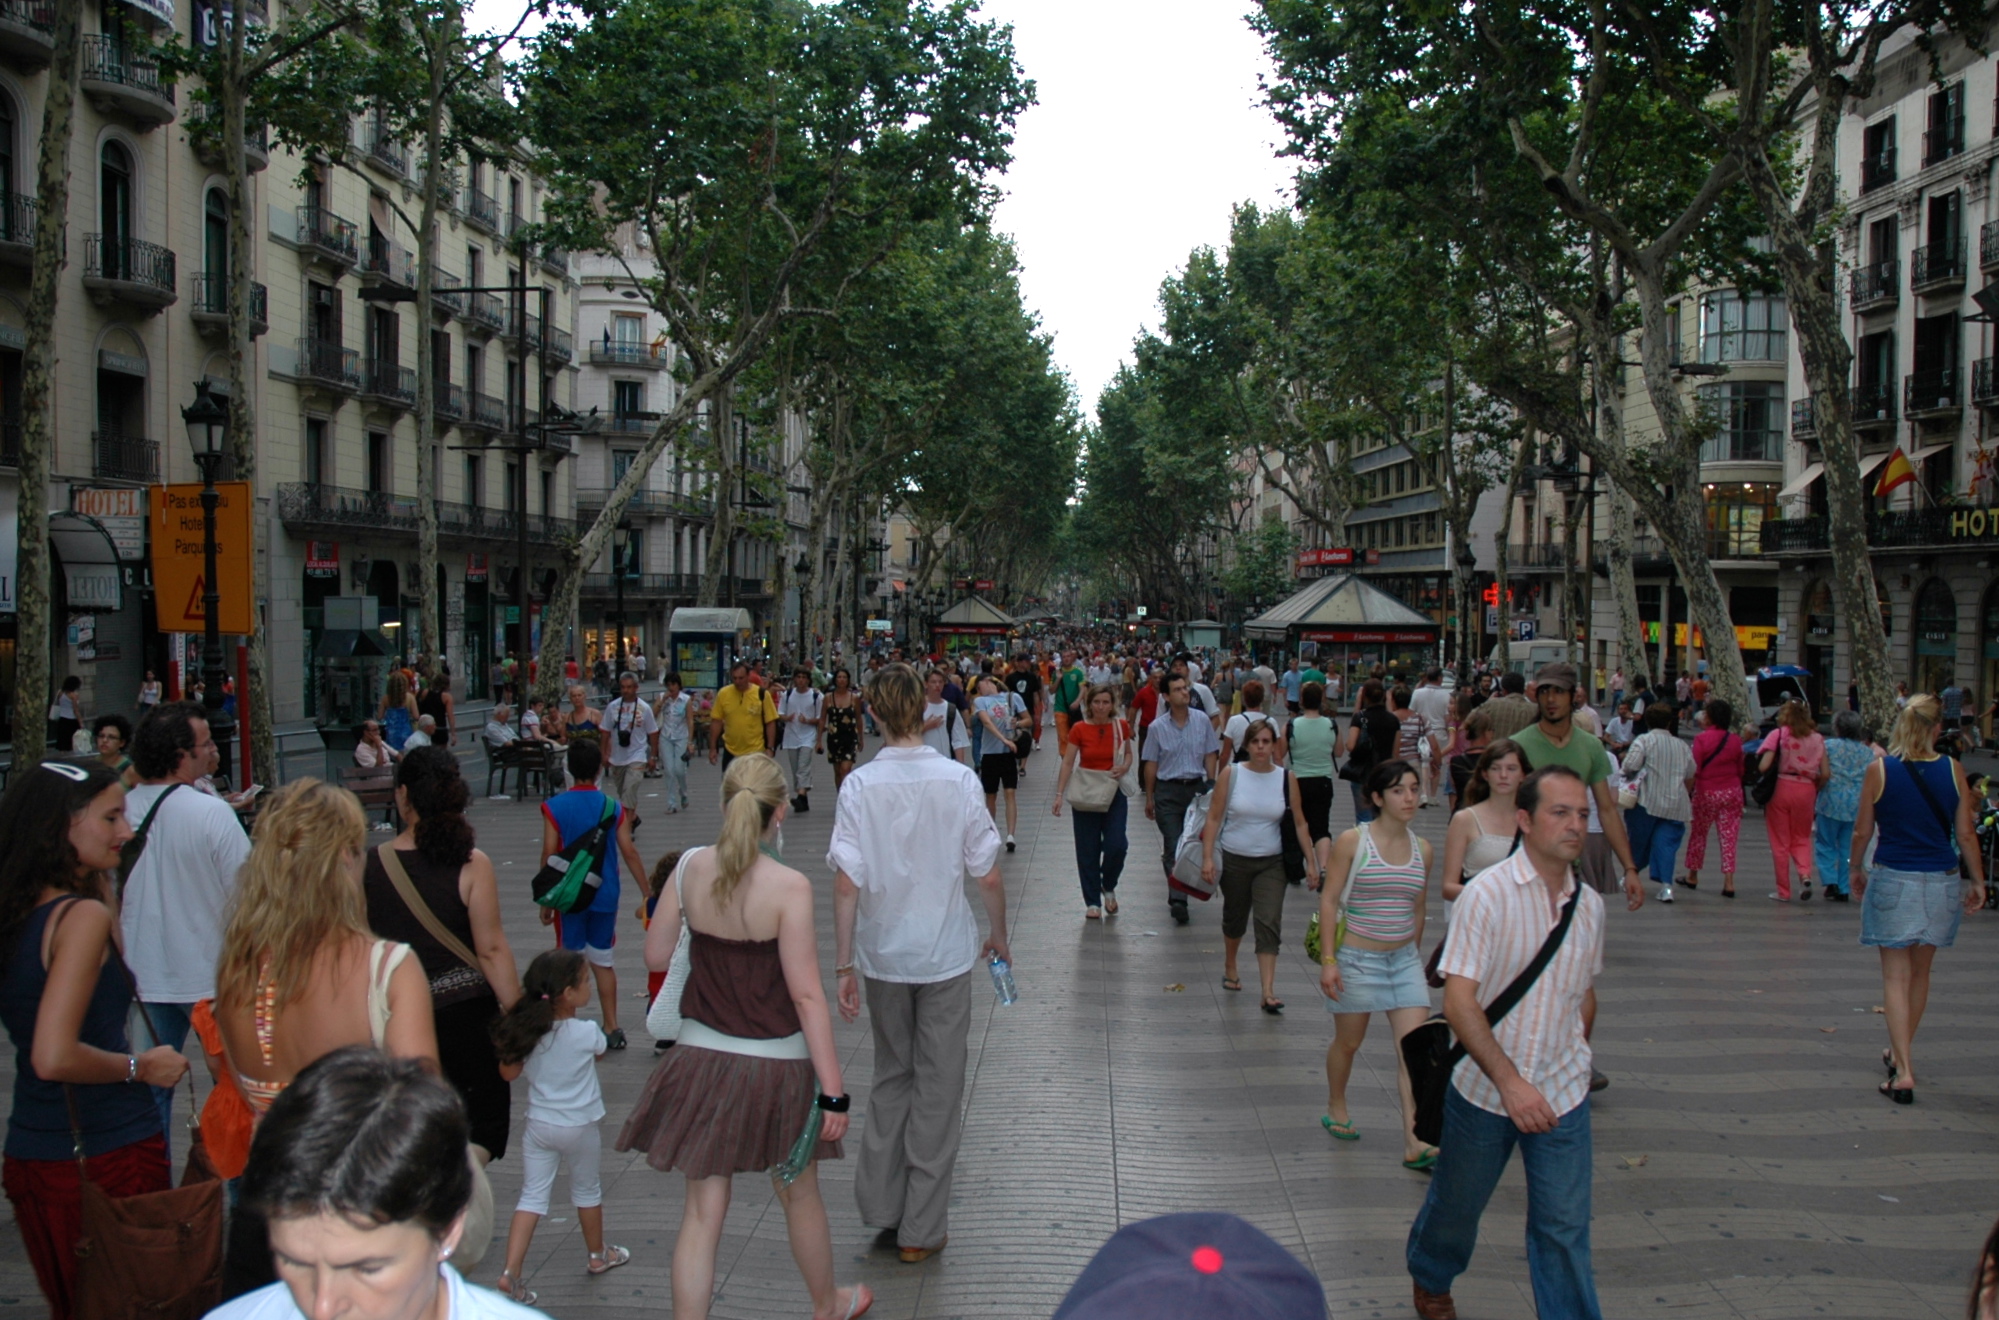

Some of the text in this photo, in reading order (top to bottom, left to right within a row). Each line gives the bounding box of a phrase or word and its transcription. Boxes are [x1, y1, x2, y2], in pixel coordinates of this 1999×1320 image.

[77, 490, 139, 516] HOTEL
[169, 494, 186, 508] Pas
[1521, 623, 1531, 635] P
